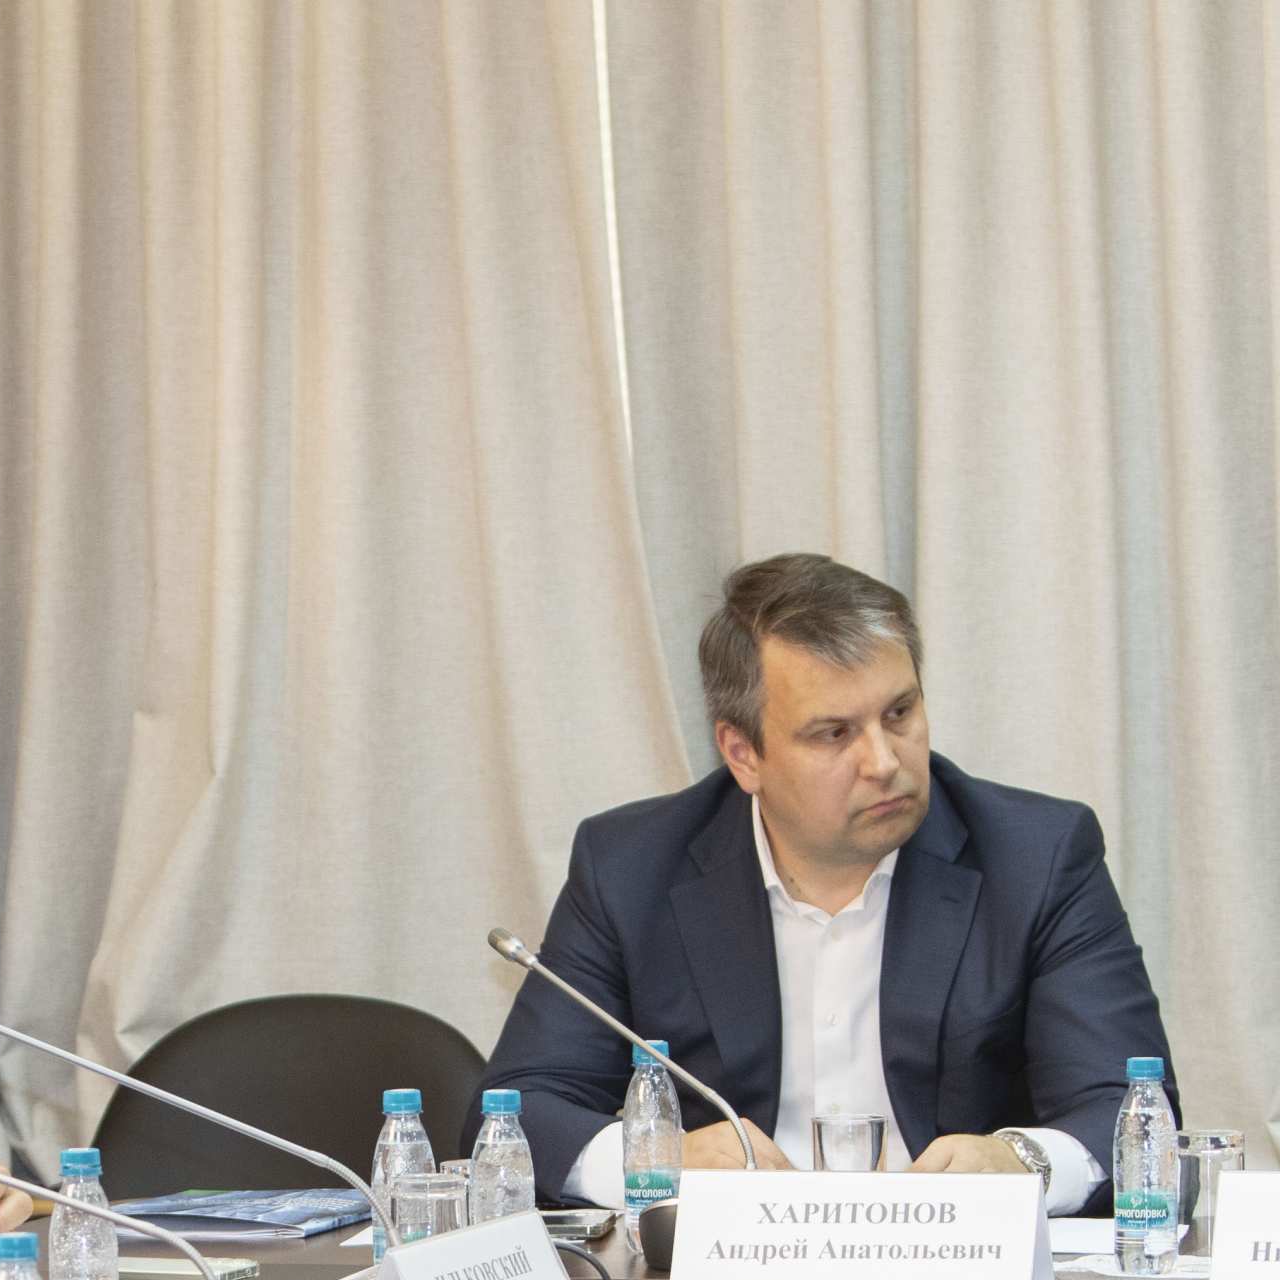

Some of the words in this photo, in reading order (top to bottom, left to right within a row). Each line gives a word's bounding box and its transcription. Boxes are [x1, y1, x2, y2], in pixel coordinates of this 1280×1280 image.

[757, 1202, 957, 1225] ХАРИТОНОВ
[706, 1238, 808, 1265] Андрей
[818, 1239, 1002, 1261] Анатольевич
